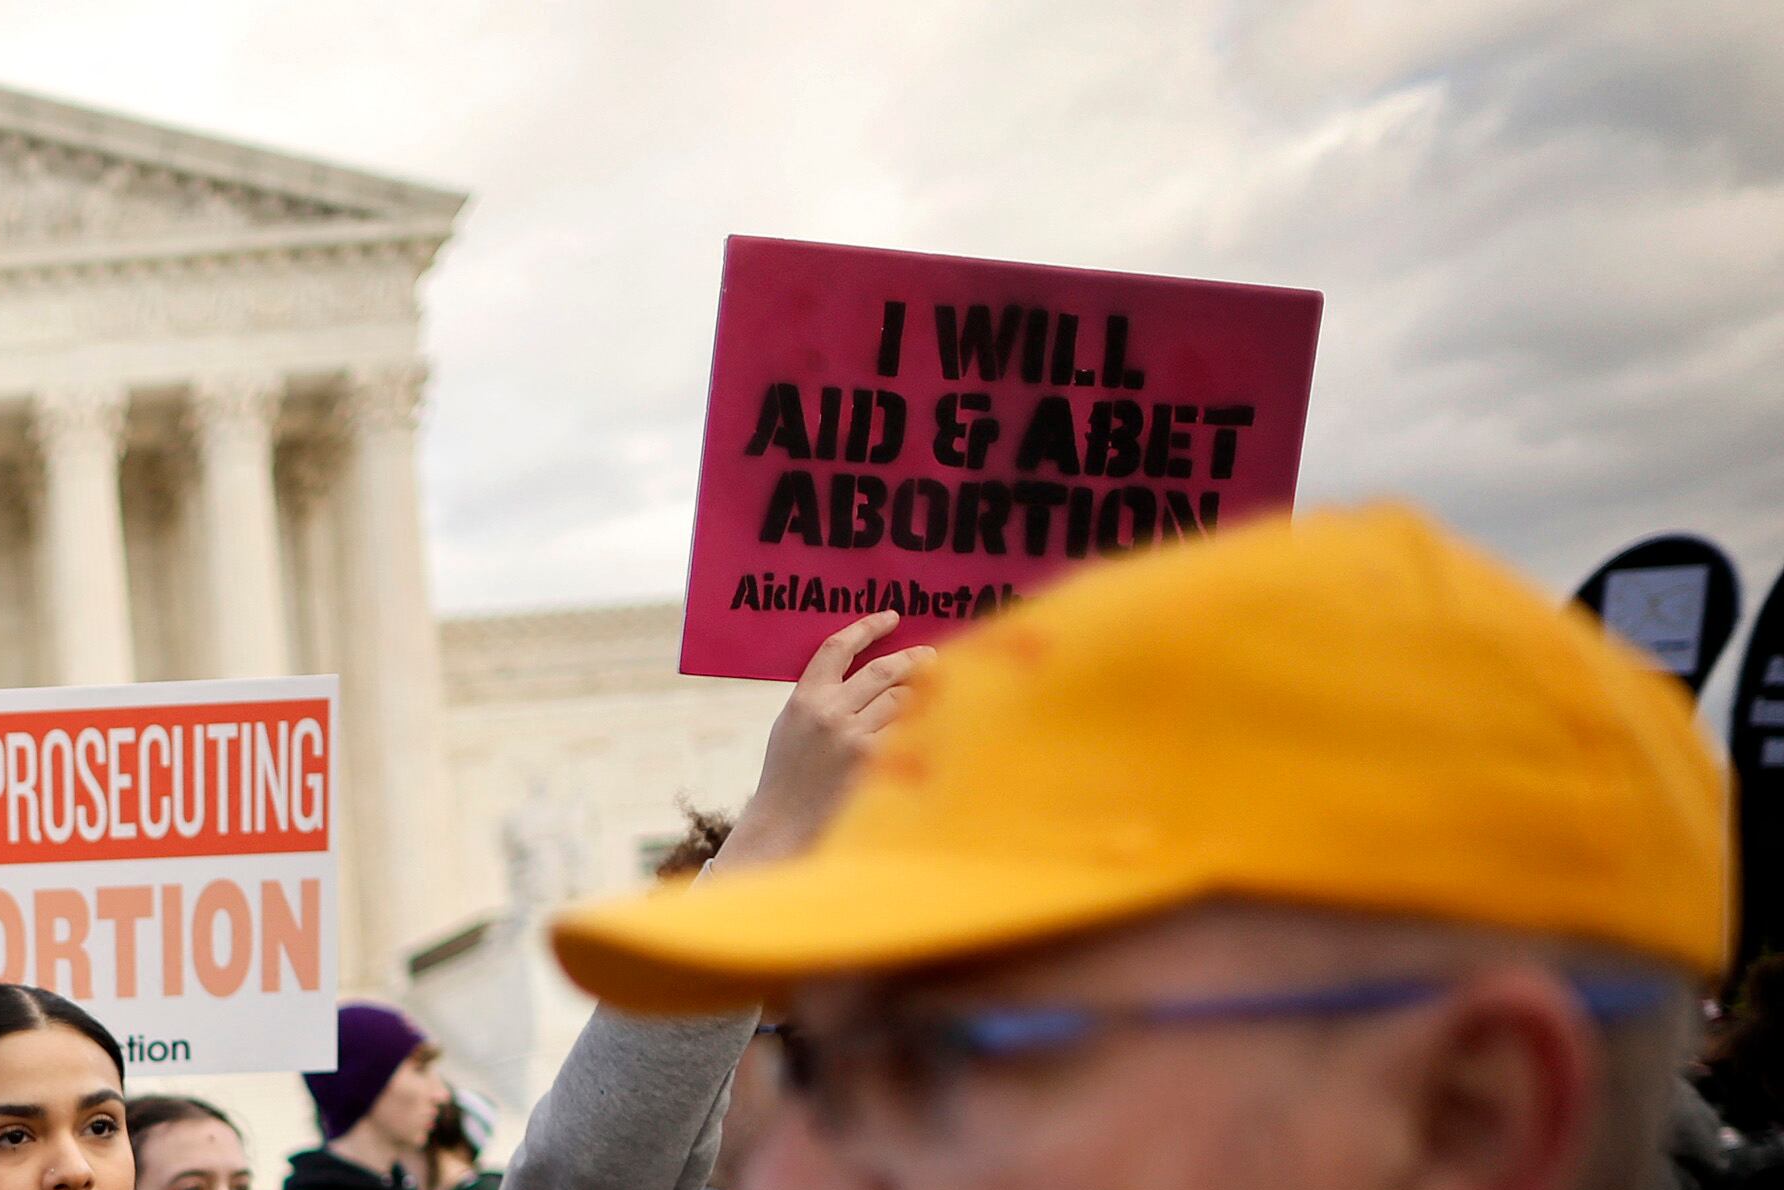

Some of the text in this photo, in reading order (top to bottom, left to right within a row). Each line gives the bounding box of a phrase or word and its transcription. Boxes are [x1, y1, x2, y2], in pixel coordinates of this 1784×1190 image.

[878, 301, 1144, 389] I WILL
[745, 383, 1255, 479] AID & ABET
[760, 470, 1221, 558] ABORTION
